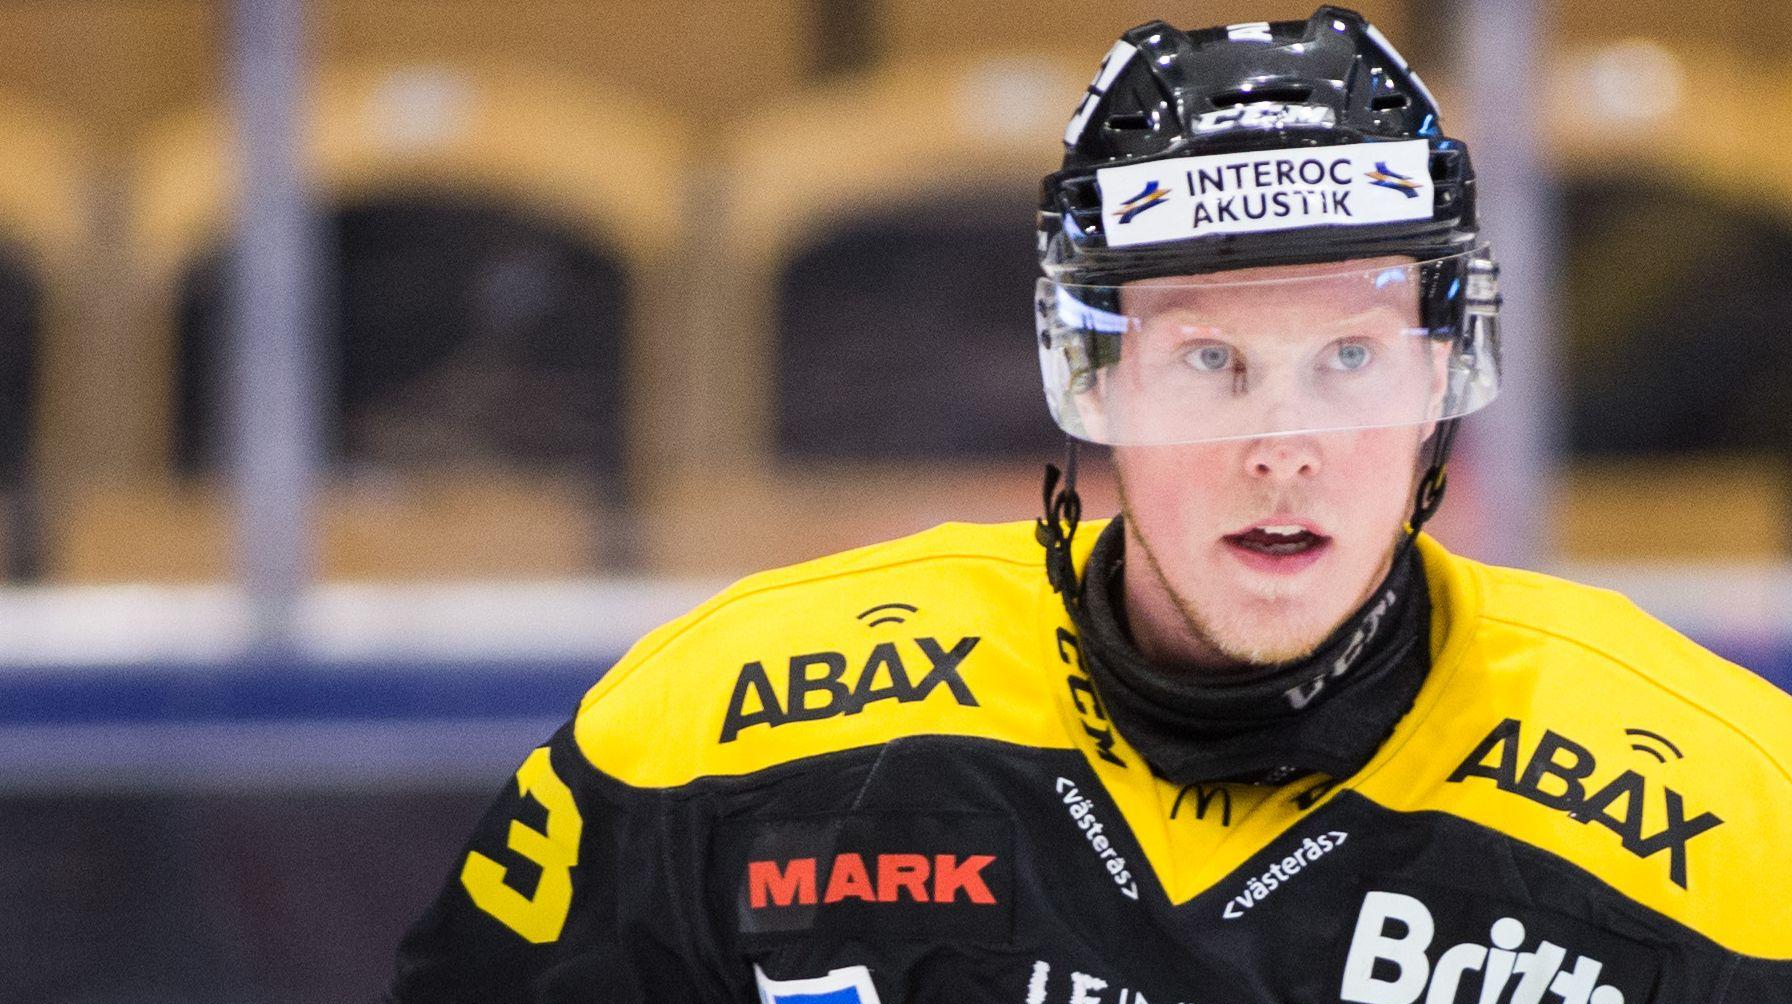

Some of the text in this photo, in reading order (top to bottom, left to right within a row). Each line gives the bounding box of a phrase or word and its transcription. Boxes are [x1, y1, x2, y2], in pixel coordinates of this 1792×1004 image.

[1186, 158, 1353, 197] INTEROC
[1192, 190, 1353, 229] AKUSTIK
[718, 636, 981, 744] ABAX
[1057, 626, 1127, 769] CCM
[1446, 717, 1725, 891] ABAX
[747, 852, 998, 909] MARK
